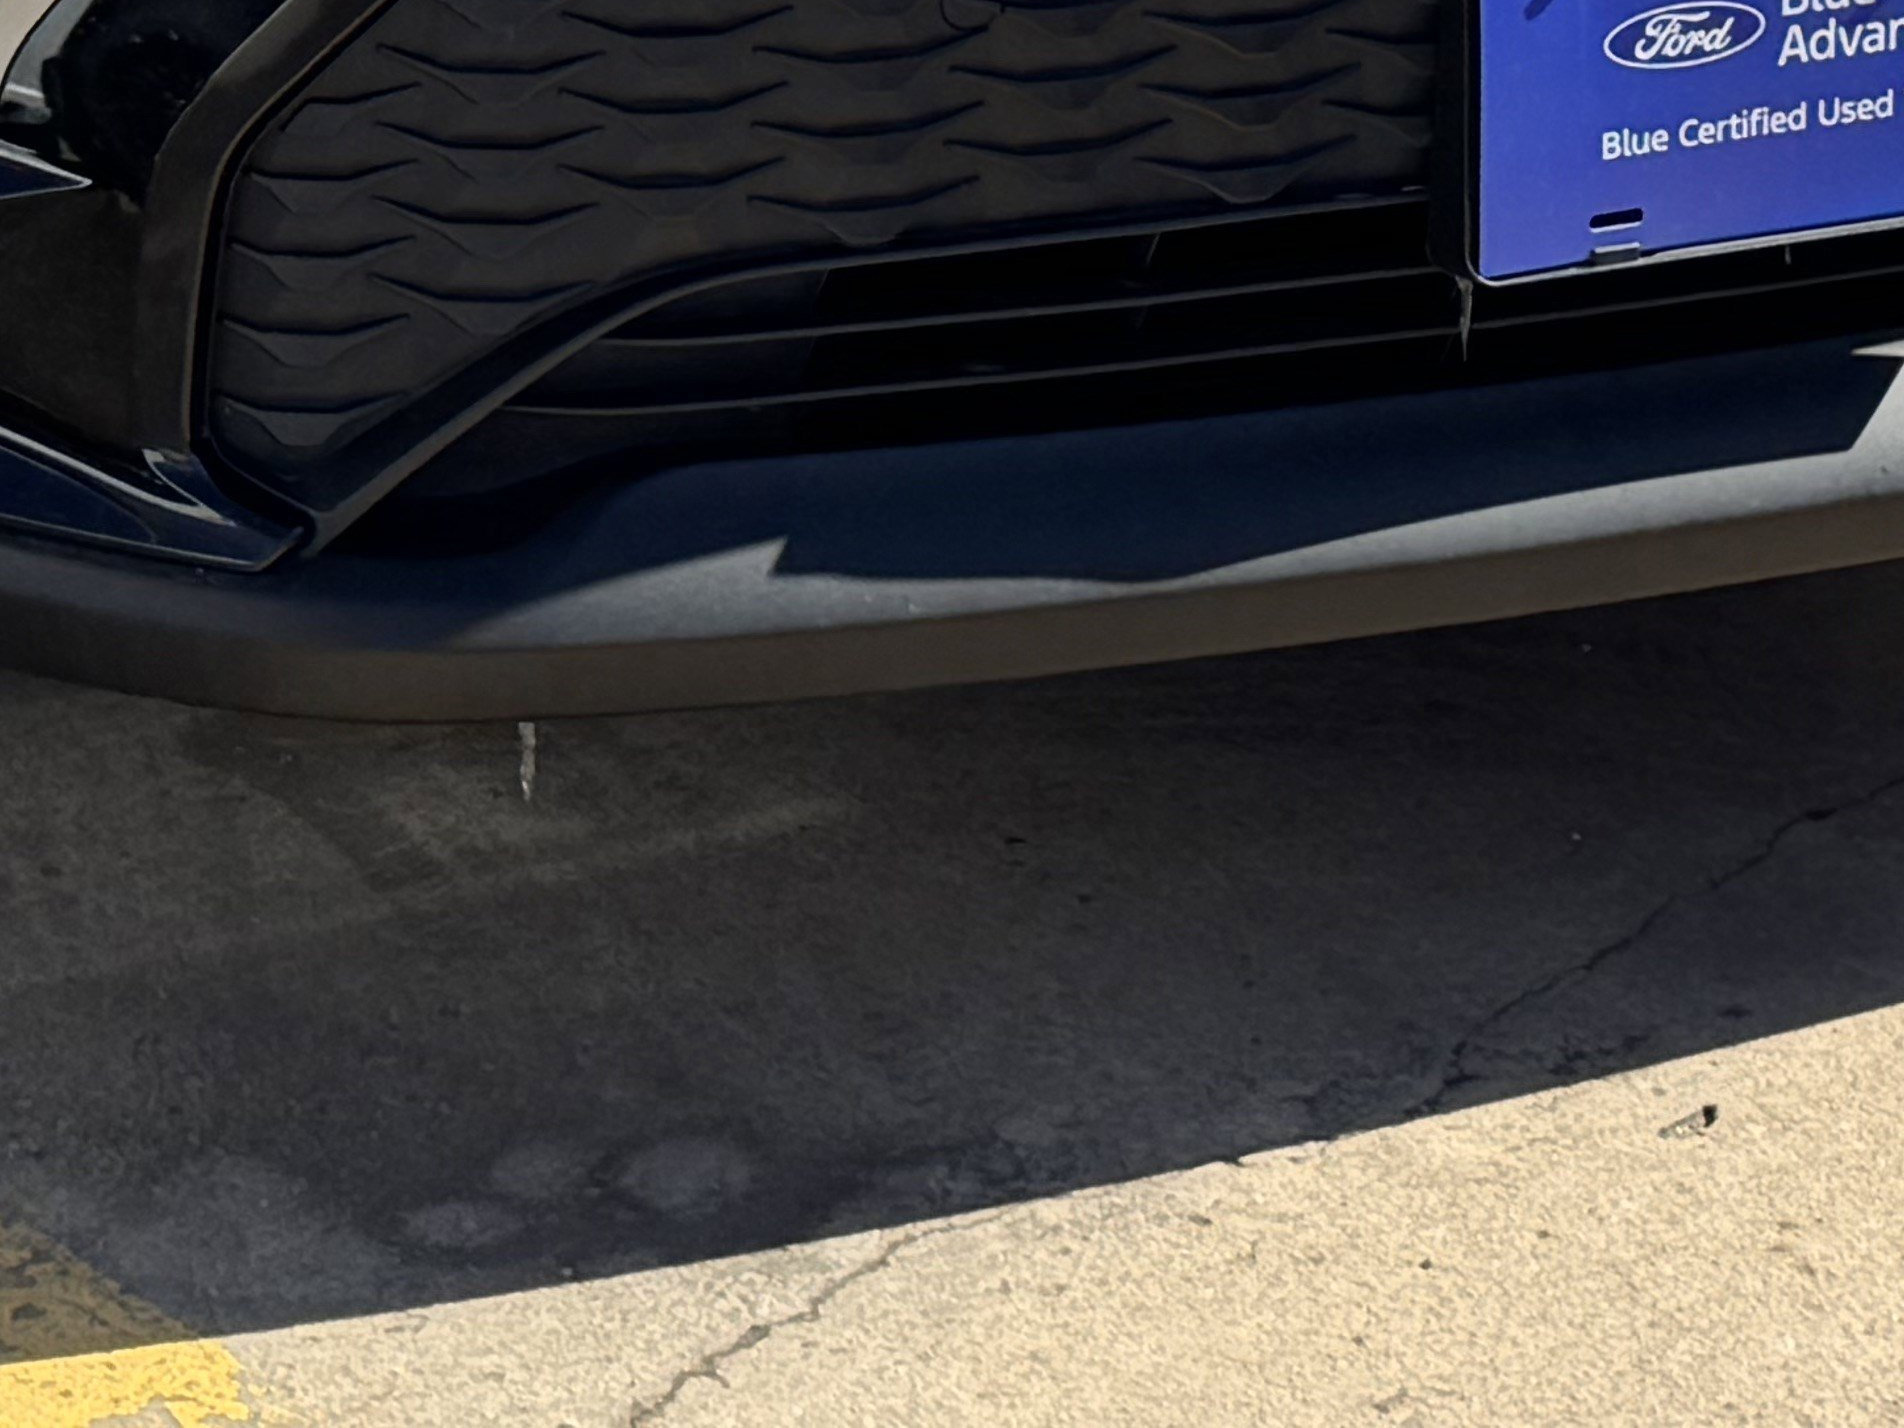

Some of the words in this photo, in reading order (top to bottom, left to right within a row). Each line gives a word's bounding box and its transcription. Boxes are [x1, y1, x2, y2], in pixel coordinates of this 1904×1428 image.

[1634, 10, 1735, 61] Ford
[1601, 128, 1670, 161] Blue
[1678, 101, 1809, 148] Certified
[1818, 88, 1895, 126] Used
